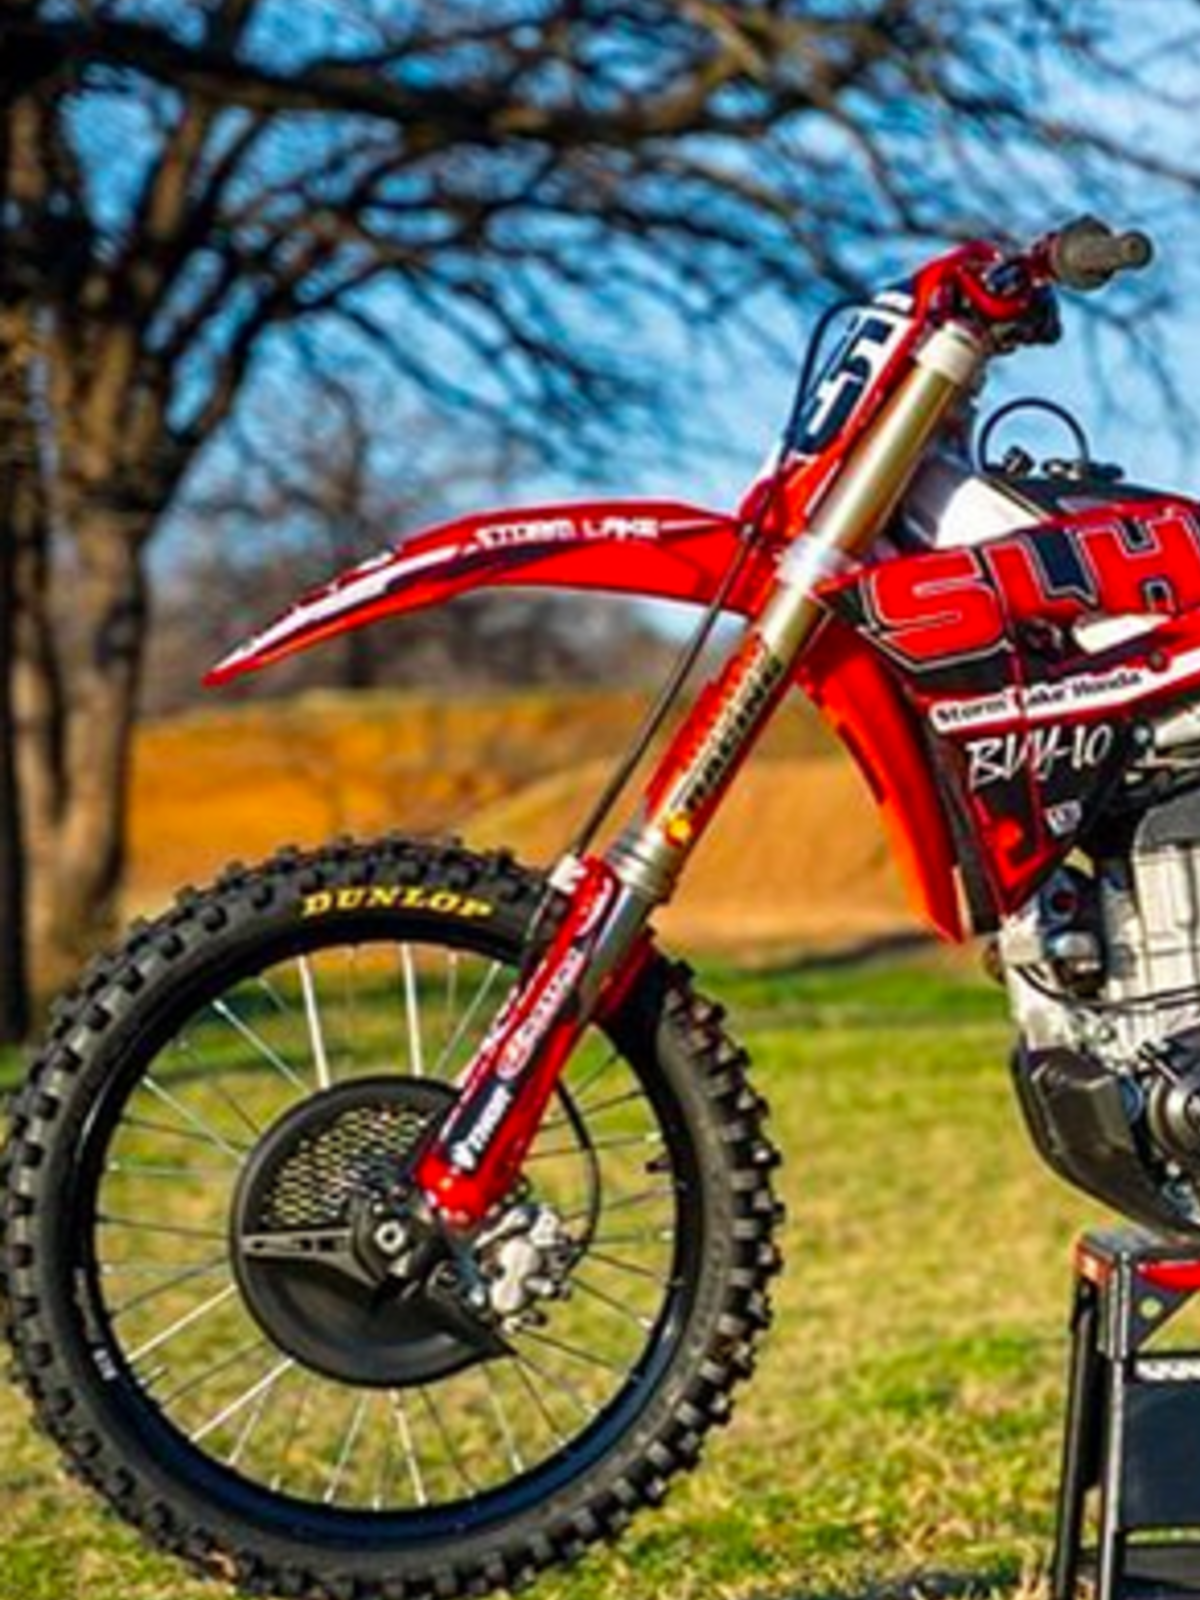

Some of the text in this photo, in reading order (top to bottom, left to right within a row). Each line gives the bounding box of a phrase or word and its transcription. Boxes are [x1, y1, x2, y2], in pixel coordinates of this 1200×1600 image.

[474, 516, 659, 550] STORM LAKE
[936, 699, 1006, 722] Storm
[1071, 670, 1142, 698] Honda
[302, 886, 493, 917] DUNLOP
[472, 1085, 512, 1152] THOR
